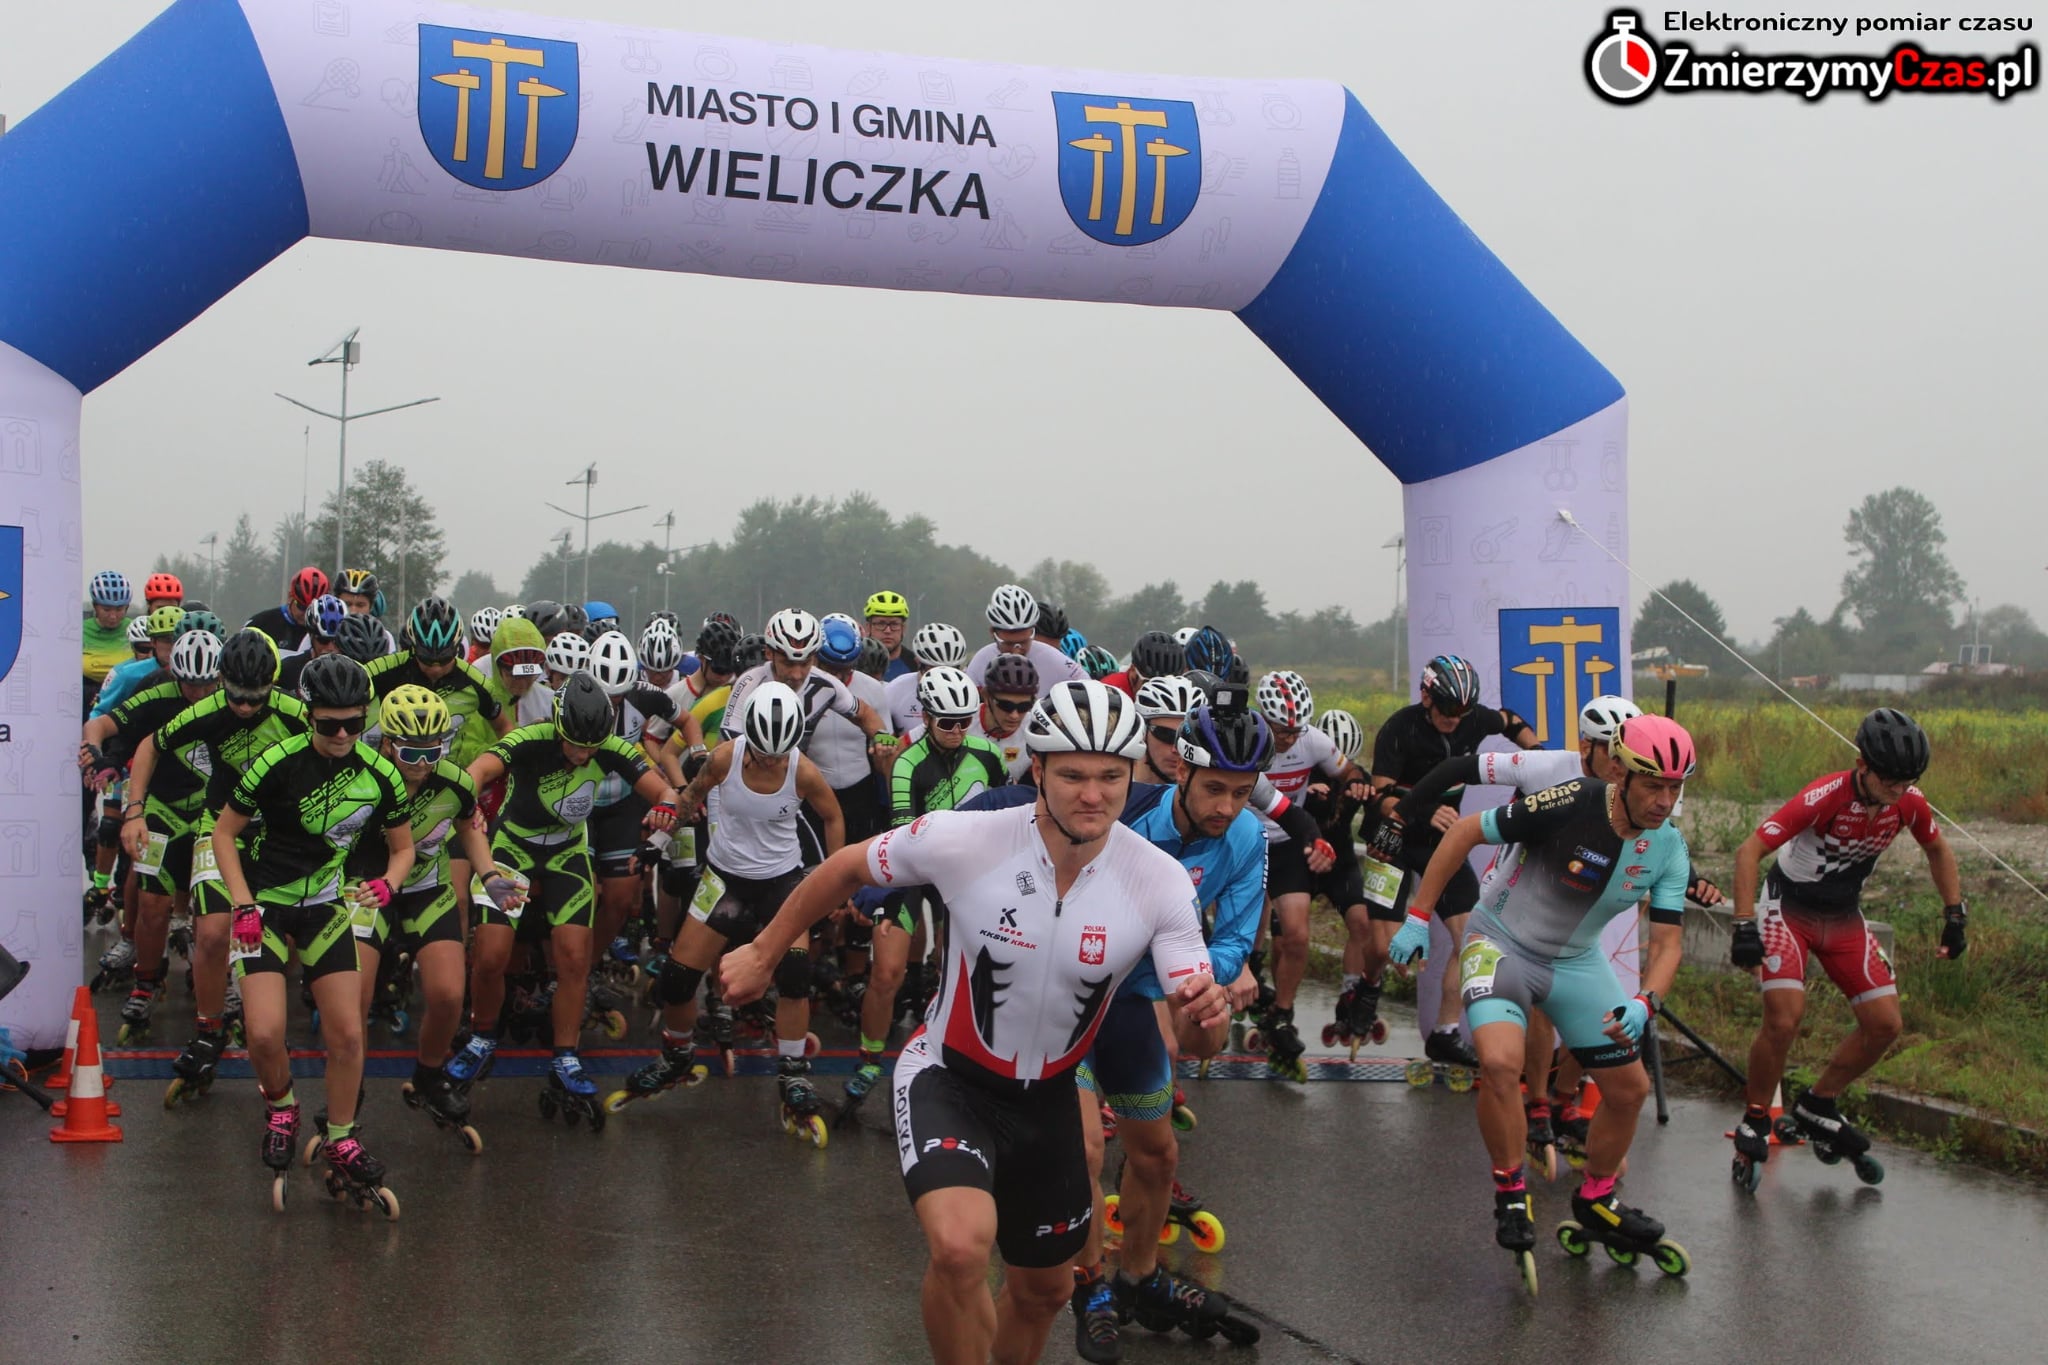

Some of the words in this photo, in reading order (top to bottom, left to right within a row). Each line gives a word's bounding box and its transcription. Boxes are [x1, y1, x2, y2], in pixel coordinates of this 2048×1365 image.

[647, 82, 818, 131] MIASTO
[832, 101, 840, 133] I
[853, 104, 997, 147] GMINA
[646, 141, 991, 220] WIELICZKA
[521, 664, 535, 674] 159
[1033, 709, 1050, 728] LAZER
[1184, 744, 1195, 761] 26
[297, 767, 356, 813] SPEED
[1803, 777, 1844, 807] TEMPISH
[1557, 794, 1575, 807] club
[878, 830, 894, 883] OLSKA
[1083, 925, 1107, 933] POLSKA
[979, 929, 1010, 943] KKSW
[1010, 939, 1039, 950] KRAK
[270, 1112, 293, 1125] SR
